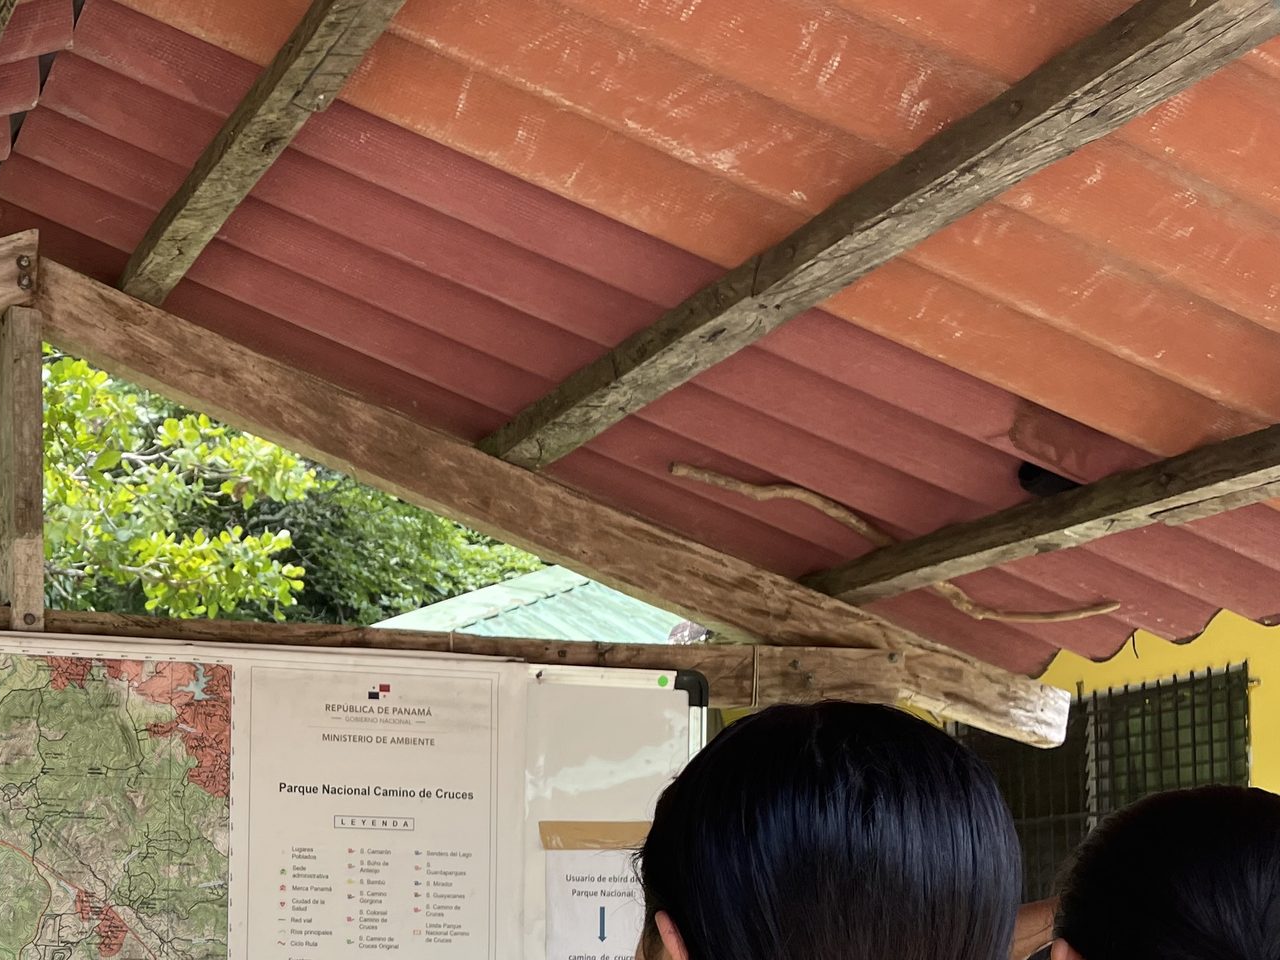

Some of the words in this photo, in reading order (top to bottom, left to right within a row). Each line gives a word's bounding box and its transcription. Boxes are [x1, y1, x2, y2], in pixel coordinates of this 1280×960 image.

[325, 703, 374, 714] REPÚBLICA
[377, 707, 390, 715] DE
[392, 707, 432, 716] PANAMÁ
[322, 734, 373, 743] MINISTERIO
[376, 736, 387, 744] DE
[390, 737, 435, 746] AMBIENTE
[279, 783, 319, 795] Parque
[322, 784, 370, 796] Nacional
[373, 787, 416, 798] Camino
[419, 789, 432, 798] de
[435, 790, 474, 800] Cruces
[572, 889, 598, 898] Parque
